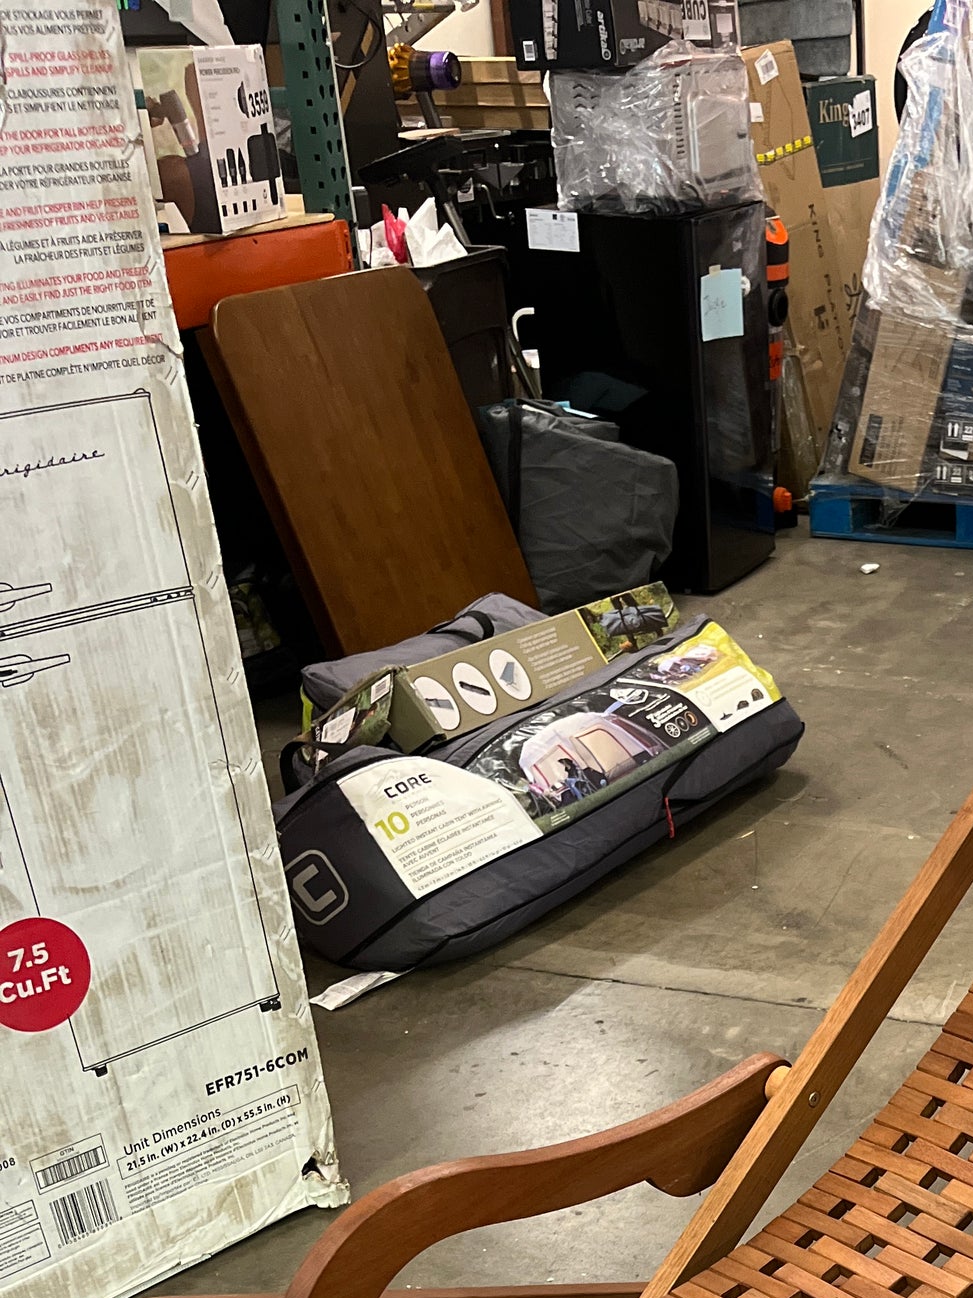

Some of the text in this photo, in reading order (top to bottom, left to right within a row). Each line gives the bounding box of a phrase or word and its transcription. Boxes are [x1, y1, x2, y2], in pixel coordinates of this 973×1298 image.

[80, 214, 96, 224] AND
[97, 210, 140, 222] VEGETABLES
[6, 238, 40, 251] LÉGUMES
[40, 238, 50, 248] ET
[57, 234, 80, 246] FRUITS
[82, 232, 98, 244] AIDE
[106, 230, 142, 242] PRÉSERVER
[14, 256, 24, 264] LA
[65, 250, 78, 260] DES
[78, 247, 102, 258] FRUITS
[103, 246, 112, 256] ET
[112, 242, 145, 255] LÉGUMES
[16, 275, 62, 290] ILLUMINATES
[62, 272, 82, 285] YOUR
[83, 270, 105, 282] FOOD
[105, 268, 122, 280] AND
[2, 294, 19, 306] AND
[20, 290, 43, 303] EASILY
[44, 288, 61, 300] FIND
[62, 287, 79, 298] JUST
[79, 286, 93, 296] THE
[92, 283, 114, 295] RIGHT
[114, 281, 138, 292] FOOD
[4, 298, 156, 326] VOS COMPARTIMENTS DE NOURRITURE DE
[16, 314, 128, 337] ET TROUVER FACILEMENT LE BON
[22, 349, 48, 362] DESIGN
[49, 342, 98, 358] COMPLIMENTS
[99, 340, 114, 350] ANY
[6, 374, 16, 384] DE
[17, 368, 46, 382] PLATINE
[46, 364, 82, 378] COMPLÈTE
[83, 359, 121, 373] N'IMPORTE
[121, 356, 141, 368] QUEL
[141, 354, 166, 366] DÉCOR
[0, 450, 105, 478] rigidaire
[384, 773, 432, 798] CORE
[374, 810, 410, 842] 10
[415, 810, 448, 827] PERSONAS
[392, 838, 416, 854] LIGHTED
[416, 826, 439, 844] INSTANT
[438, 818, 455, 833] CABIN
[455, 814, 468, 824] TENT
[399, 850, 420, 864] TENTE
[402, 846, 440, 869] AVEC AUVENT
[408, 862, 430, 878] TIENDA
[430, 858, 438, 868] DE
[443, 860, 454, 872] CON
[7, 942, 50, 974] 7.5
[204, 1047, 310, 1096] EFR751-6COM
[124, 1108, 222, 1156] Unit Dimensions
[126, 1094, 291, 1172] 21.5 in. (W) x 22.4 in. (D) x 55.5 in. (H)
